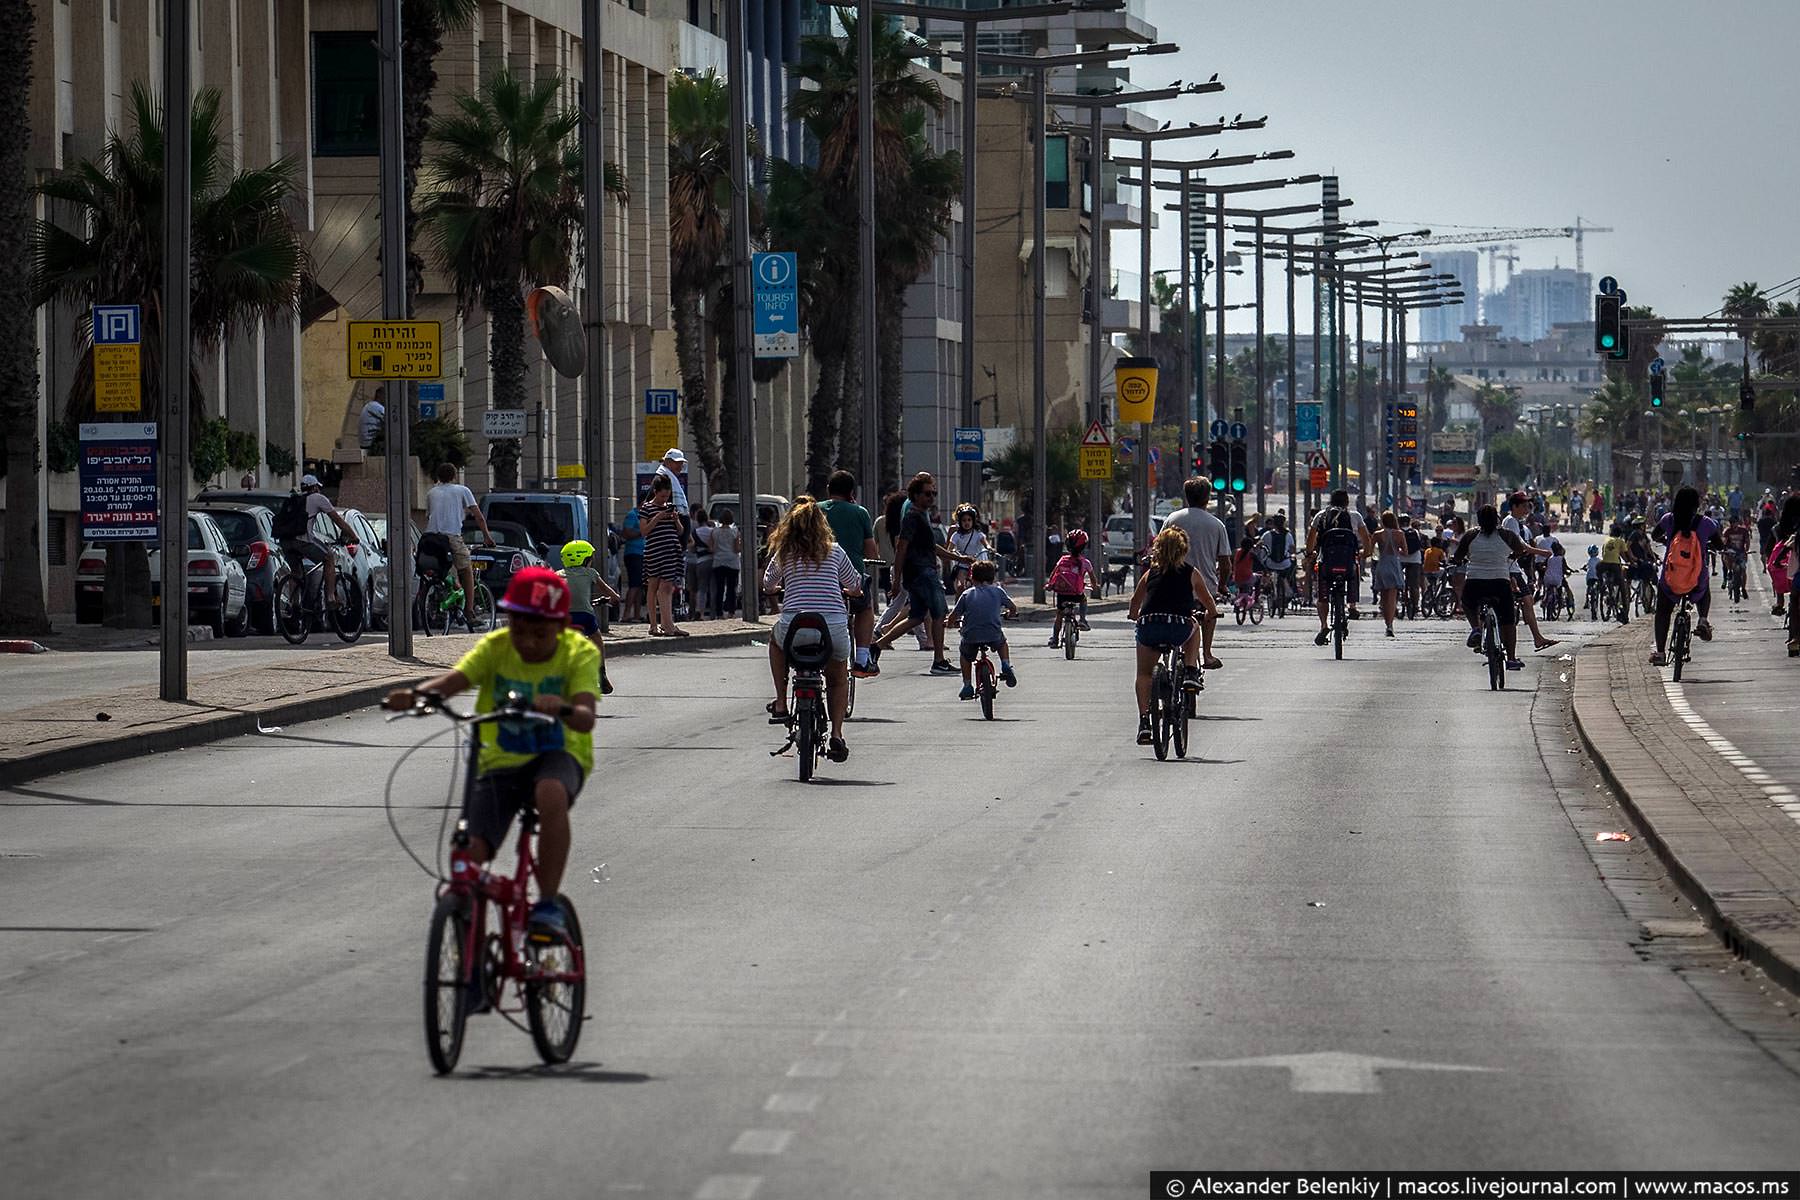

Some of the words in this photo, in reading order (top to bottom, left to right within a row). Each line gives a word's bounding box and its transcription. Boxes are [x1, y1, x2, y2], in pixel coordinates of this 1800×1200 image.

[757, 293, 794, 302] TOURIST
[765, 302, 787, 311] INFO
[373, 327, 416, 339] זהירות
[357, 341, 392, 350] מהירות
[396, 341, 432, 350] מכמונת
[405, 351, 433, 362] לפניך
[392, 363, 414, 373] לאט
[418, 363, 432, 373] סע
[425, 406, 432, 416] 2
[96, 477, 120, 485] אסורה
[83, 486, 114, 494] 20.10.16
[107, 502, 133, 510] למחרת
[112, 513, 133, 521] חונה
[135, 512, 154, 521] רכב
